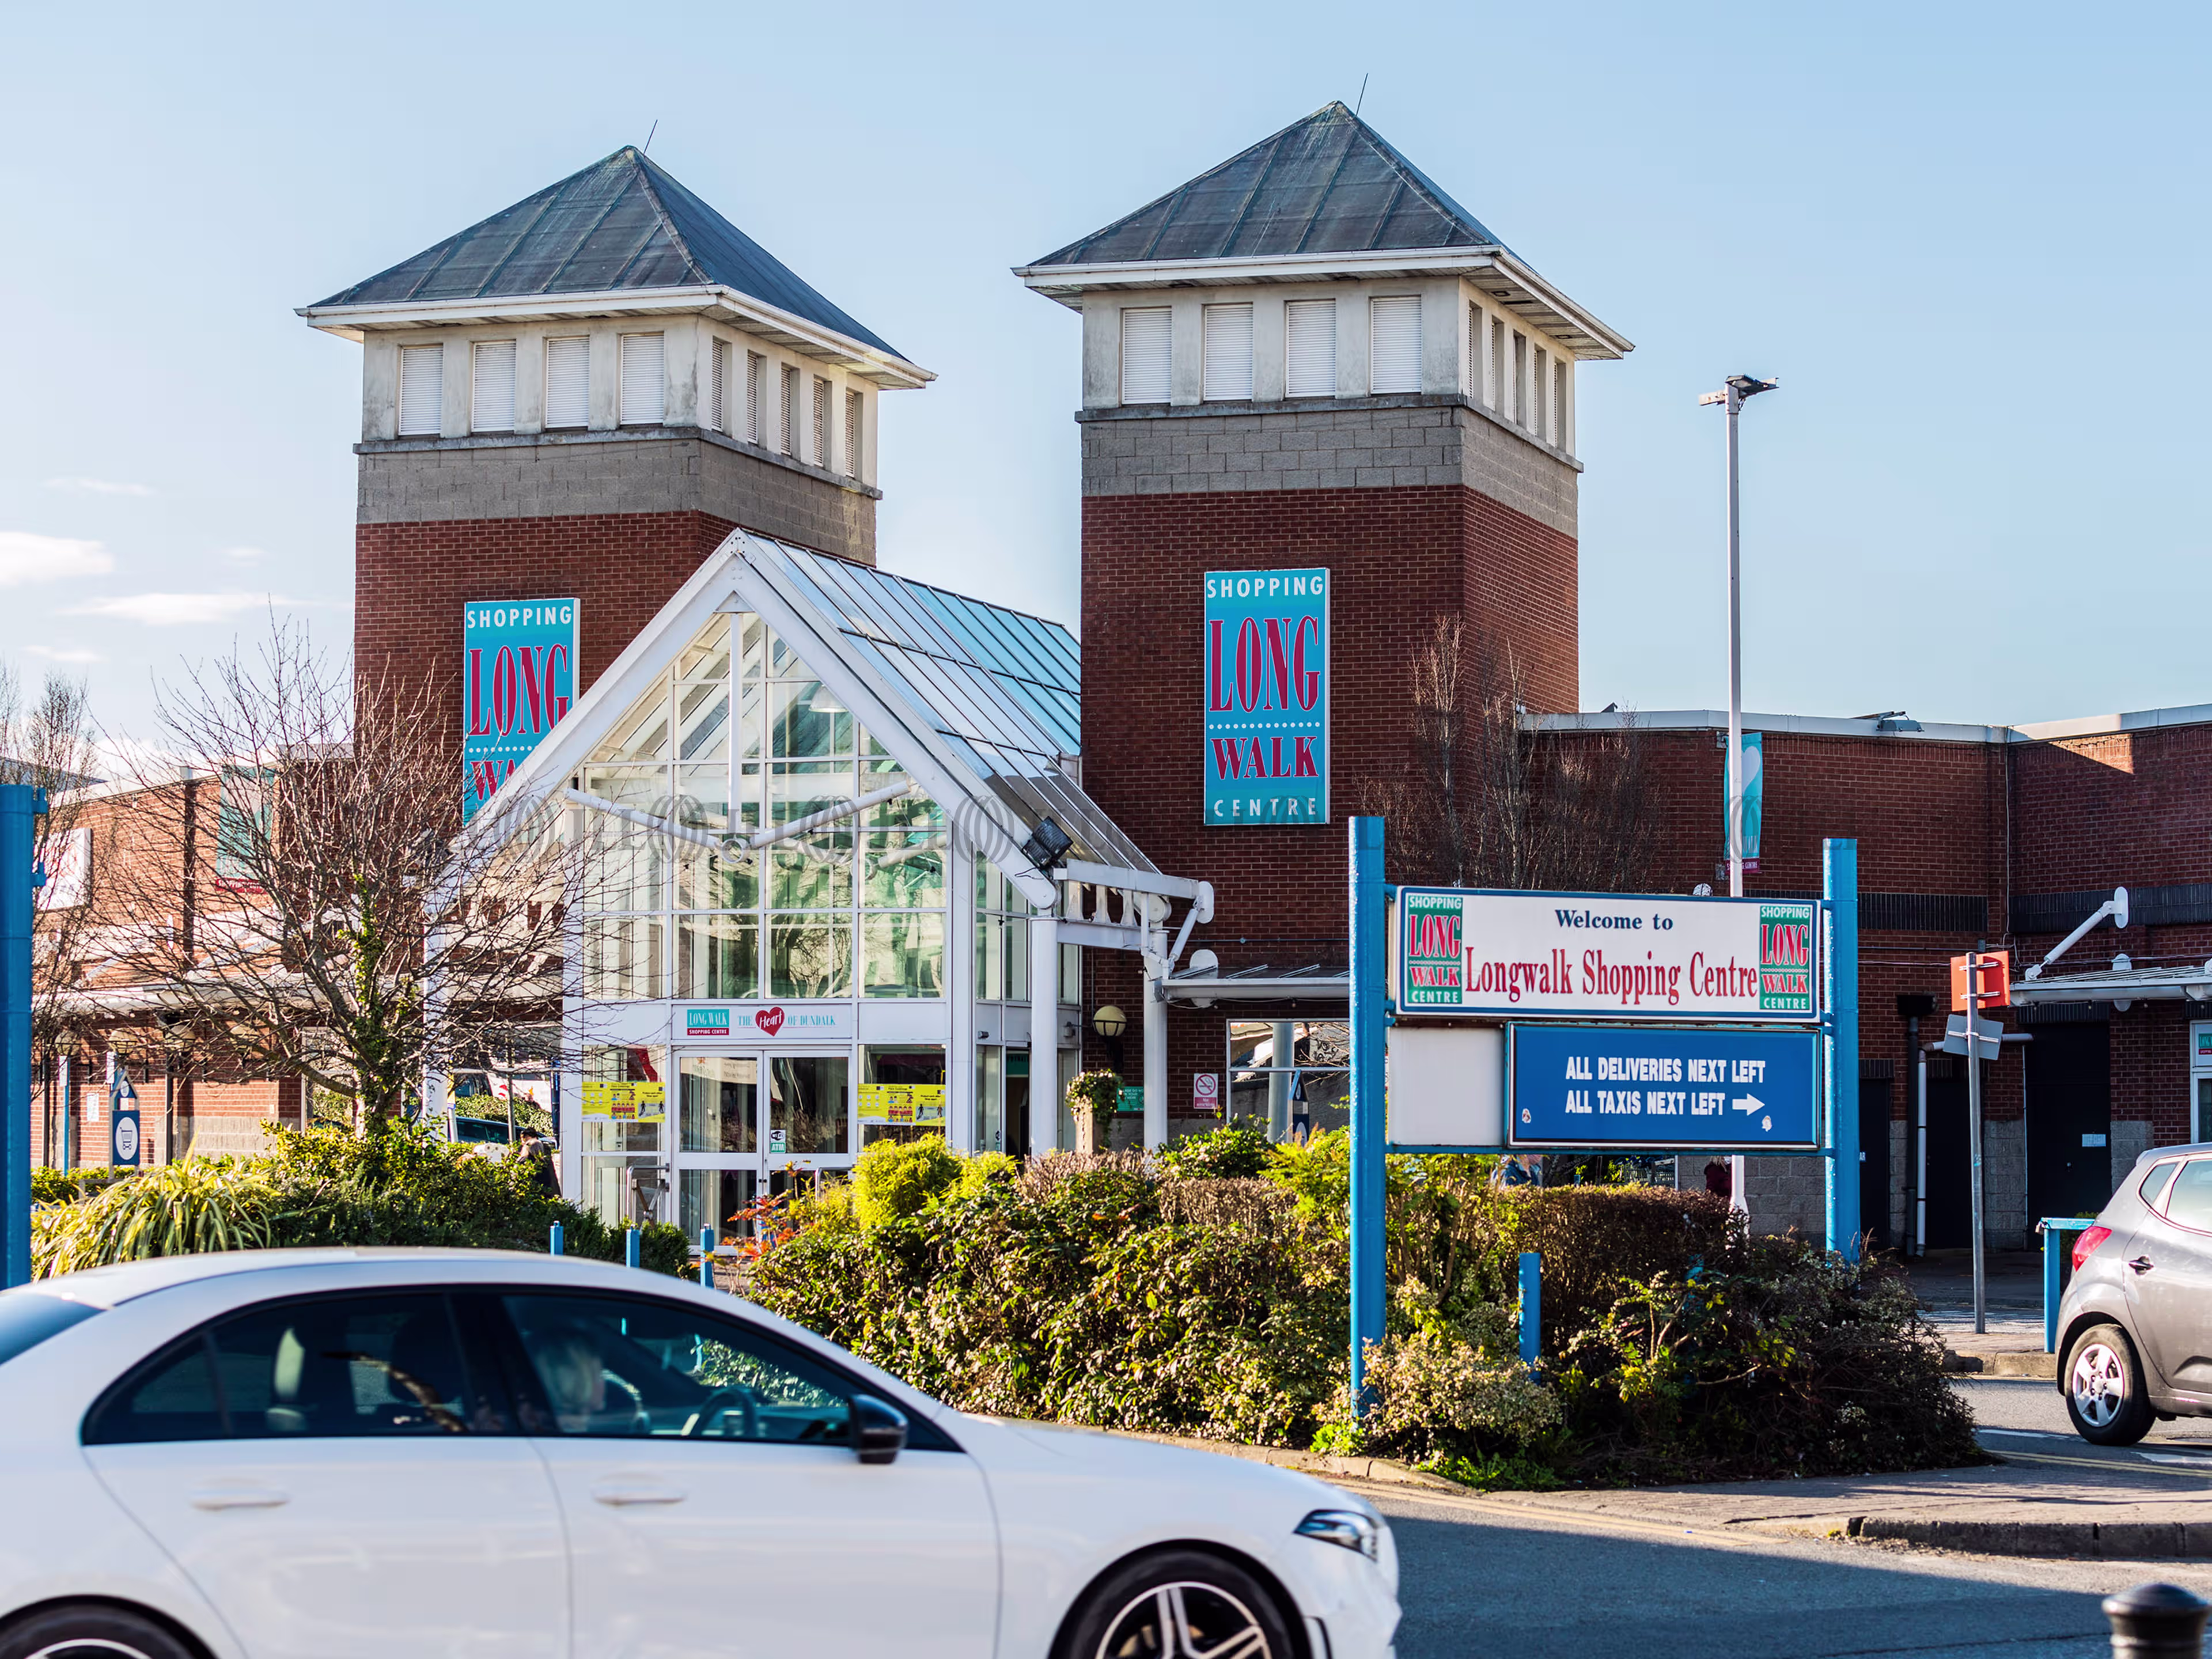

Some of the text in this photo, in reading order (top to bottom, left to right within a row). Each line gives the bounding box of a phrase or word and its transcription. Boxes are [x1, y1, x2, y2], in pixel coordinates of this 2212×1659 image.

[1207, 576, 1323, 598] SHOPPING
[467, 605, 572, 628] SHOPPING
[1209, 615, 1320, 713] LONG
[469, 643, 569, 737] LONG
[1210, 736, 1319, 780] WALK
[1214, 797, 1316, 817] CENTRE
[1410, 896, 1462, 909] SHOPPING
[1761, 906, 1809, 918] SHOPPING
[1555, 910, 1673, 930] Welcome to
[1409, 914, 1461, 959] LONG
[1761, 923, 1809, 966] LONG
[1410, 966, 1461, 987] WALK
[1465, 947, 1758, 1005] Longwalk Shopping Centre
[1762, 974, 1808, 994] WALK
[1411, 990, 1458, 1003] CENTRE
[1763, 998, 1806, 1009] CENTRE
[689, 1012, 727, 1025] LONG WALK
[738, 1010, 836, 1029] THE Heart OF DUNDALK
[1566, 1056, 1766, 1083] ALL DELIVERIES NEXT LEFT
[1565, 1090, 1725, 1115] ALL TAXIS NEXT LEFT
